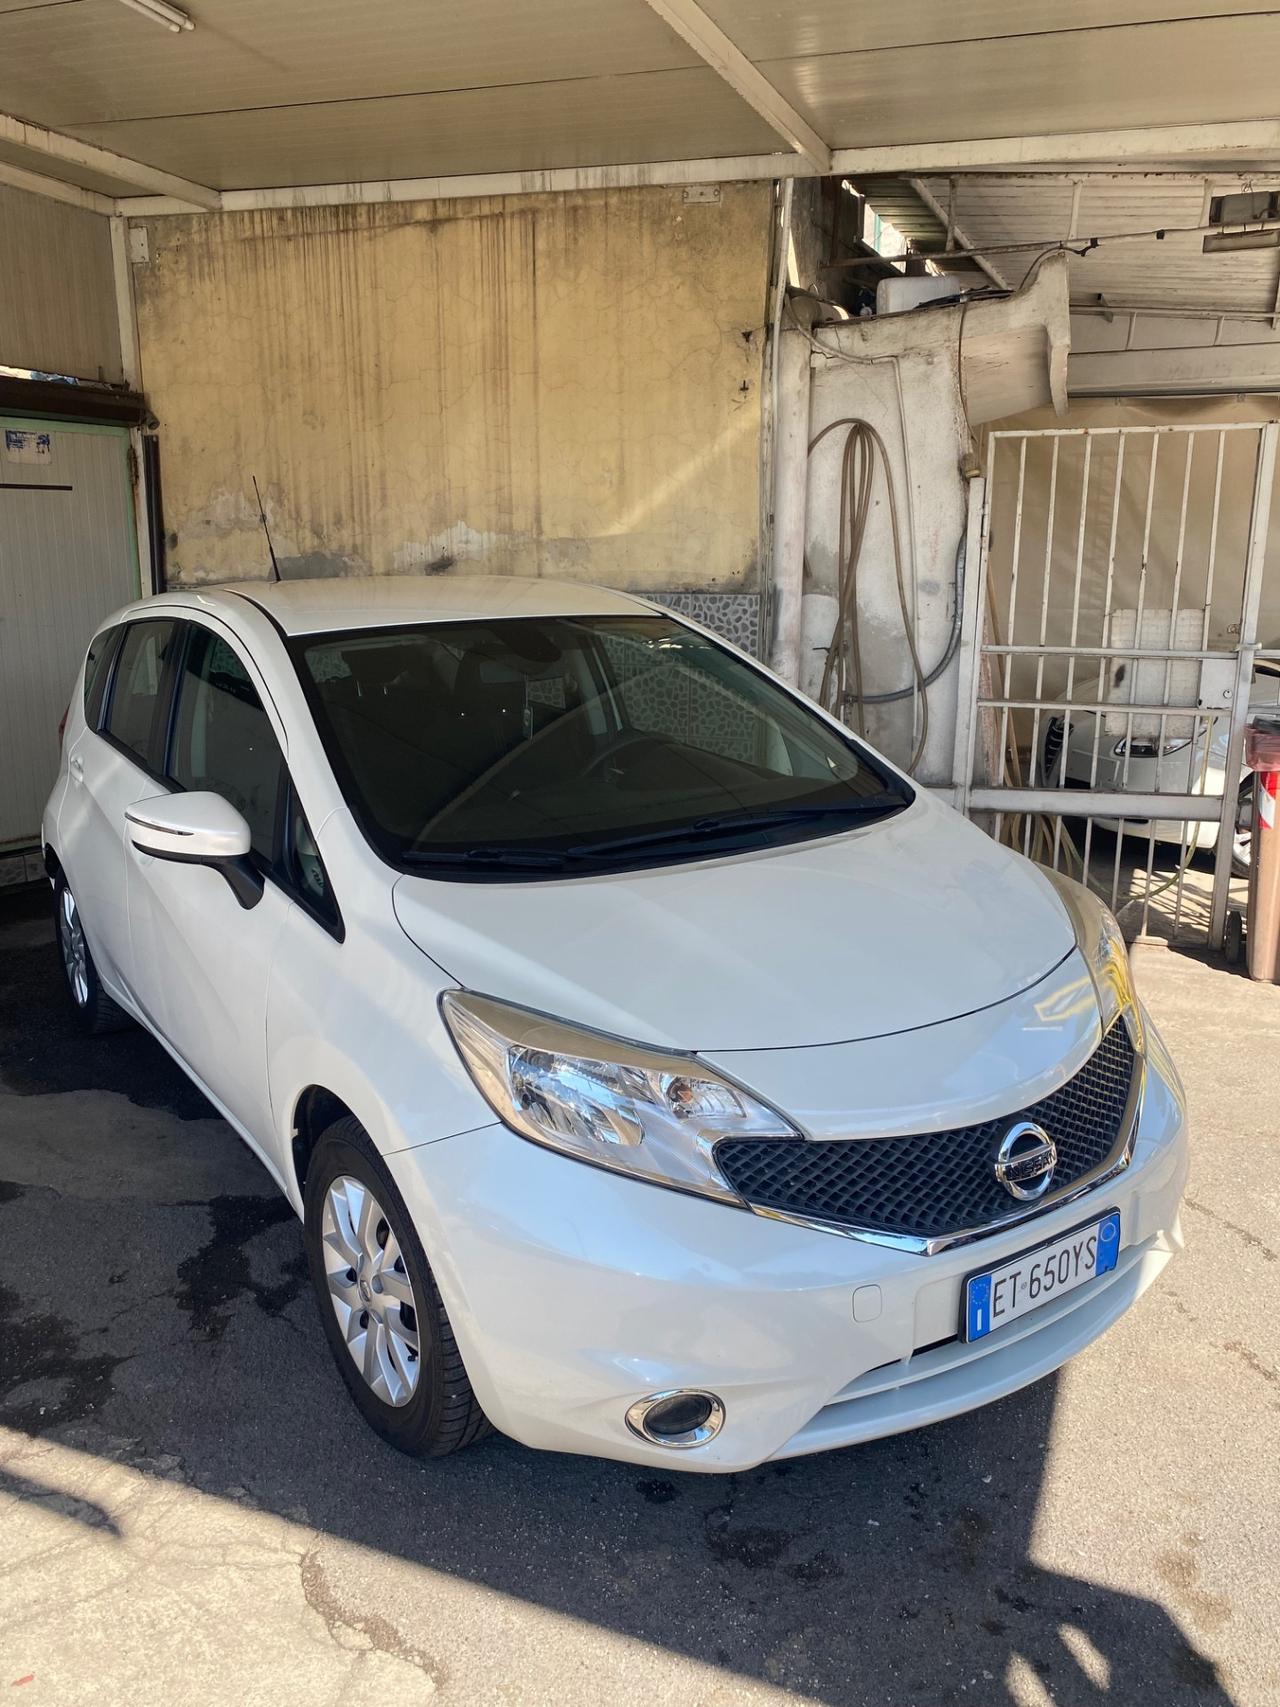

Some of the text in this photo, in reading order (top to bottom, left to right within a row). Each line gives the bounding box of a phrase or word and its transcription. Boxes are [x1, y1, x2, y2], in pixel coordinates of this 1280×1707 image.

[1007, 1152, 1055, 1180] NISSAN
[993, 1236, 1097, 1317] ET 650YS
